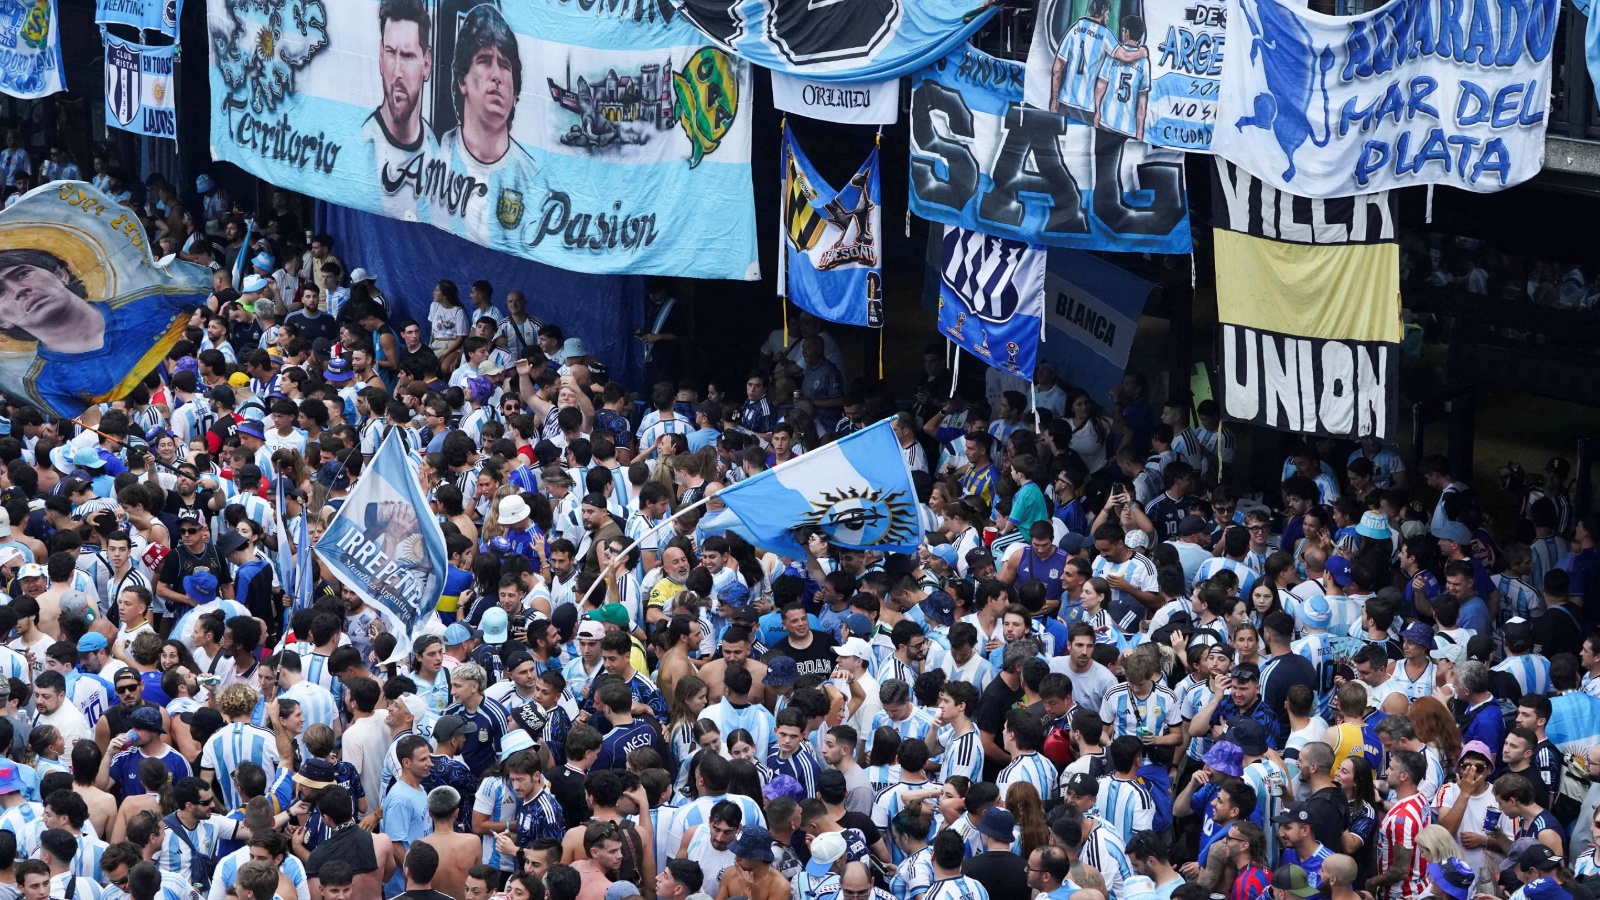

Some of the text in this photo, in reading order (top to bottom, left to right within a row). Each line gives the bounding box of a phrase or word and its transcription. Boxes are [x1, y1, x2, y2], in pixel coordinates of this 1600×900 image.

[116, 50, 132, 61] CLUB
[802, 84, 871, 109] ORLANDO
[1117, 72, 1133, 104] 5
[1339, 75, 1546, 136] MAR DEL
[221, 91, 342, 175] Territorio
[1163, 125, 1212, 146] CIUDAD
[1355, 128, 1511, 186] PLATA
[381, 151, 488, 218] Amor
[522, 191, 660, 250] Pasion
[1055, 292, 1117, 348] BLANCA
[1223, 323, 1388, 440] UNION
[344, 558, 412, 620] Mendoza Argentina
[623, 733, 652, 754] MESSI
